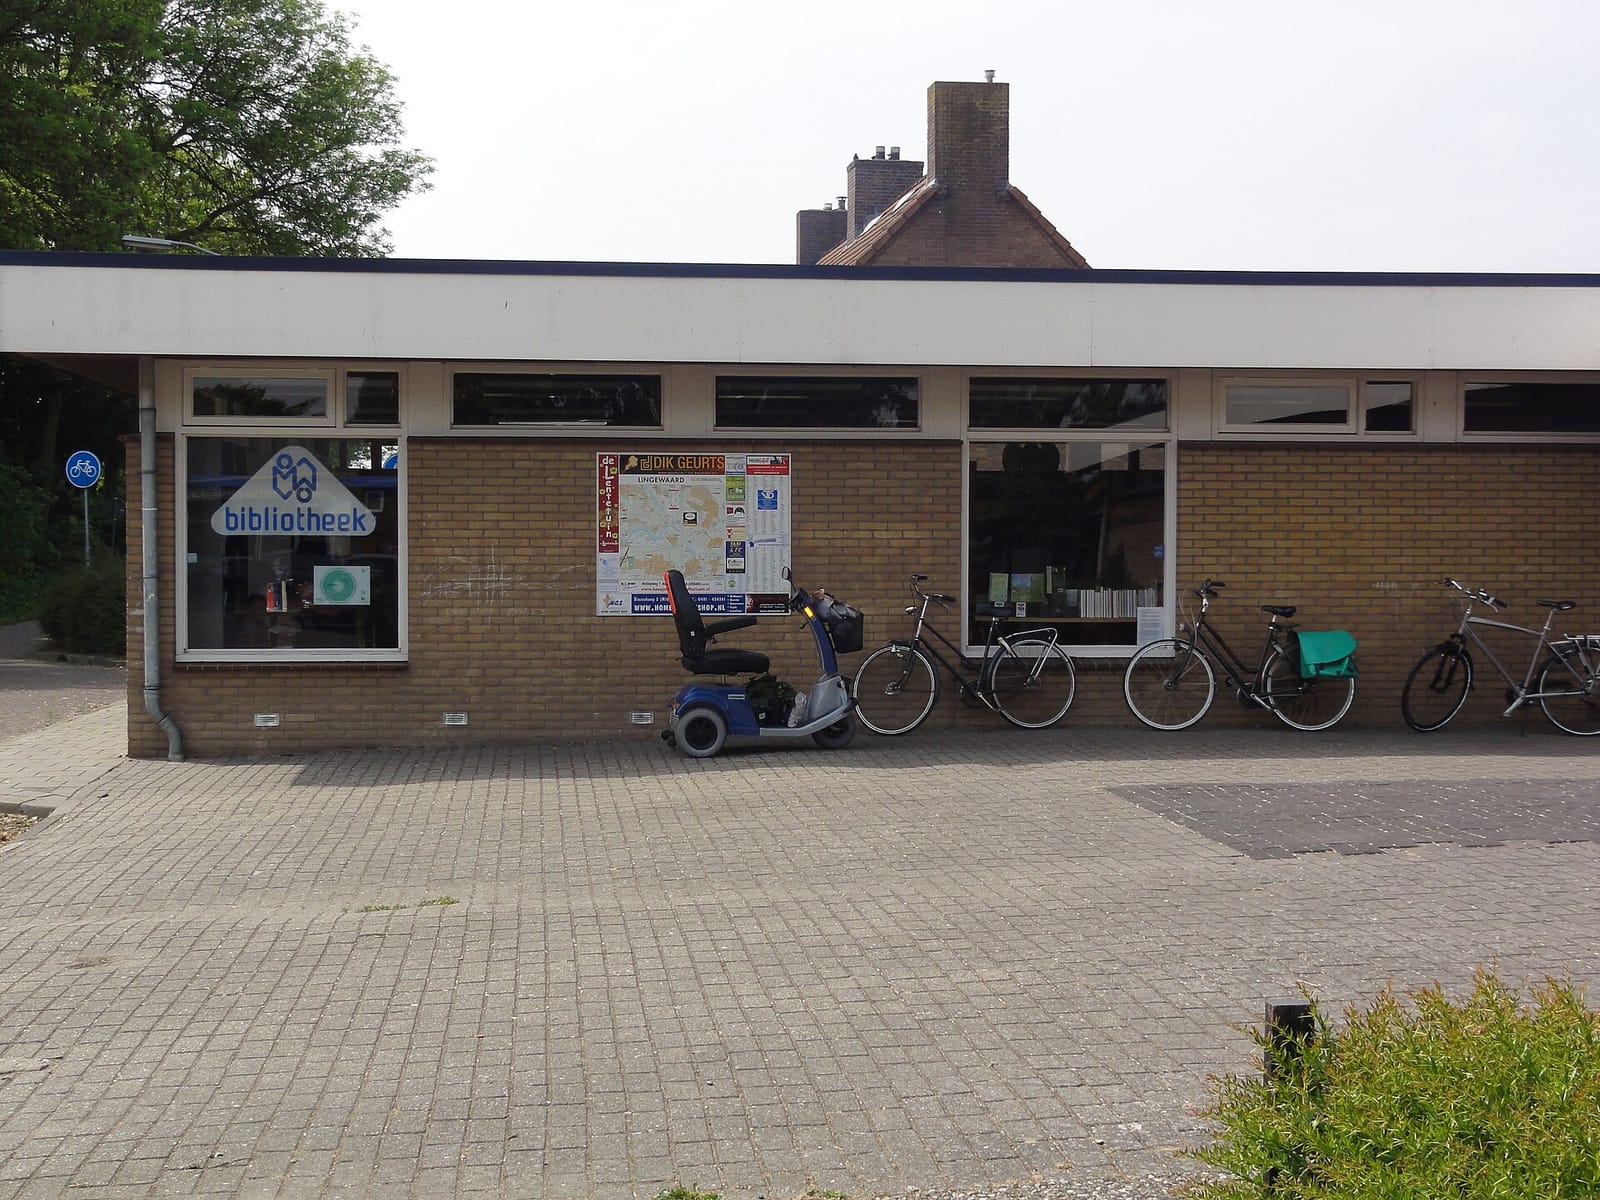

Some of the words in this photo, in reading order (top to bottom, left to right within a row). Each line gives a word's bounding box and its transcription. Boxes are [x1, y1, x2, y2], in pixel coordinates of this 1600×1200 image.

[653, 456, 674, 469] DIK
[677, 456, 725, 469] GEURTS
[637, 476, 685, 484] LINGEWAARD
[225, 506, 367, 532] bibliotheek
